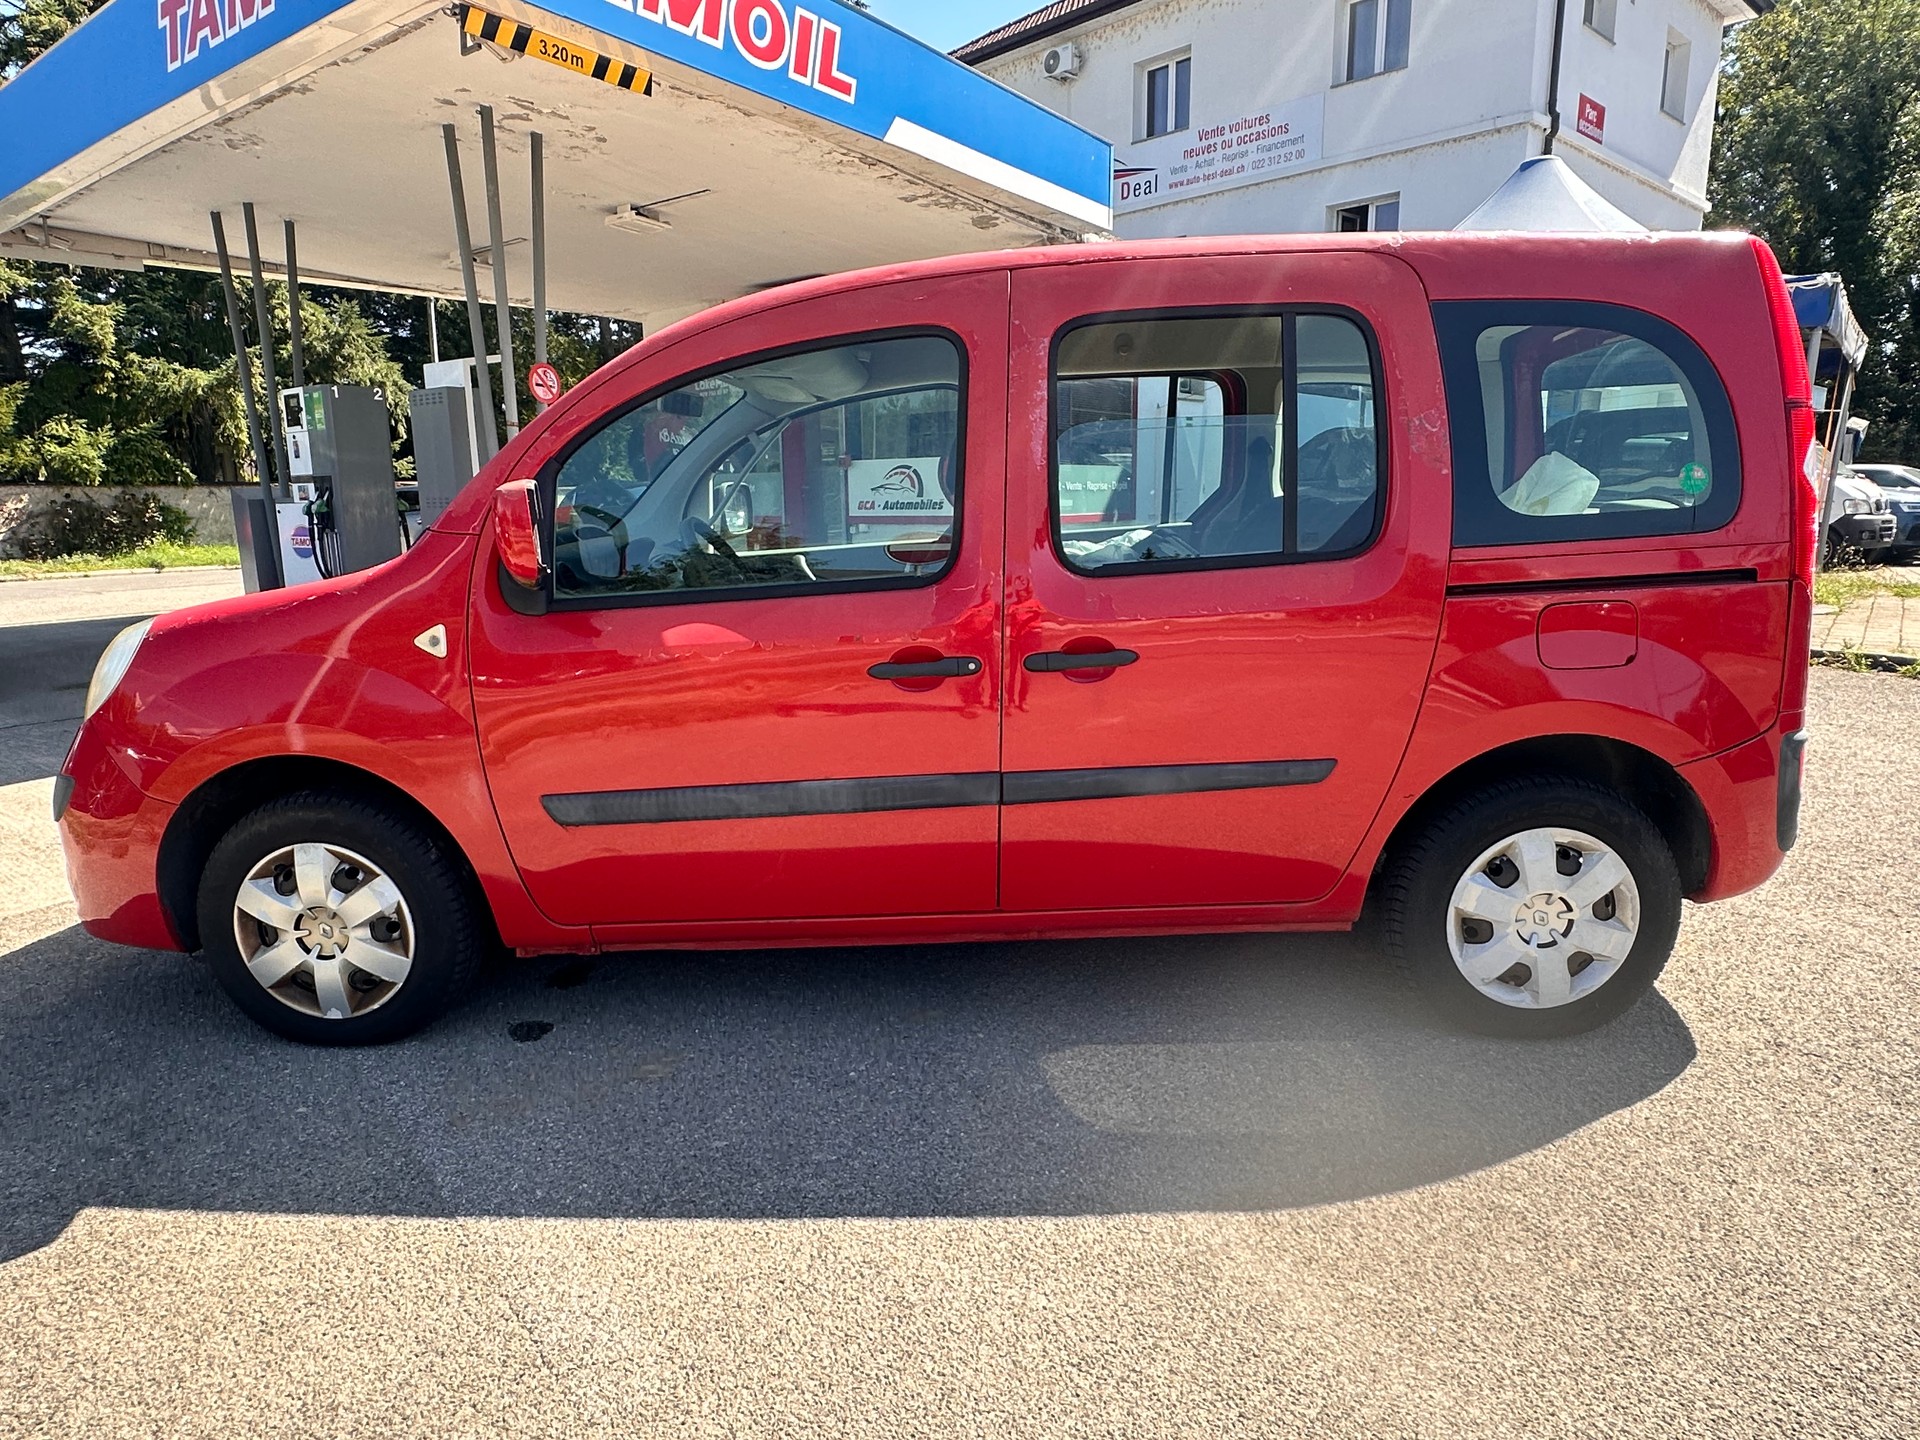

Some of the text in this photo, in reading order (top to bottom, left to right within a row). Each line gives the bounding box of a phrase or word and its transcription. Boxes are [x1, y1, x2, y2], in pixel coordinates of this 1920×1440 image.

[539, 39, 584, 69] 3.20 m
[1183, 122, 1290, 160] neuves ou occasions
[1198, 113, 1270, 142] Vente voitures
[1168, 164, 1245, 189] www.auto-best-deal.ch
[1251, 158, 1265, 170] 022
[1267, 154, 1281, 167] 312
[1283, 151, 1293, 163] 52
[1295, 148, 1305, 160] 00
[1169, 165, 1188, 176] Vente
[1194, 157, 1215, 170] Achat
[1221, 149, 1249, 163] Reprise
[1256, 134, 1305, 155] Financement
[1121, 173, 1158, 200] Deal
[331, 385, 339, 398] 1
[373, 387, 384, 400] 2
[857, 499, 945, 511] GCA Automobiles
[291, 538, 310, 547] TAMO
